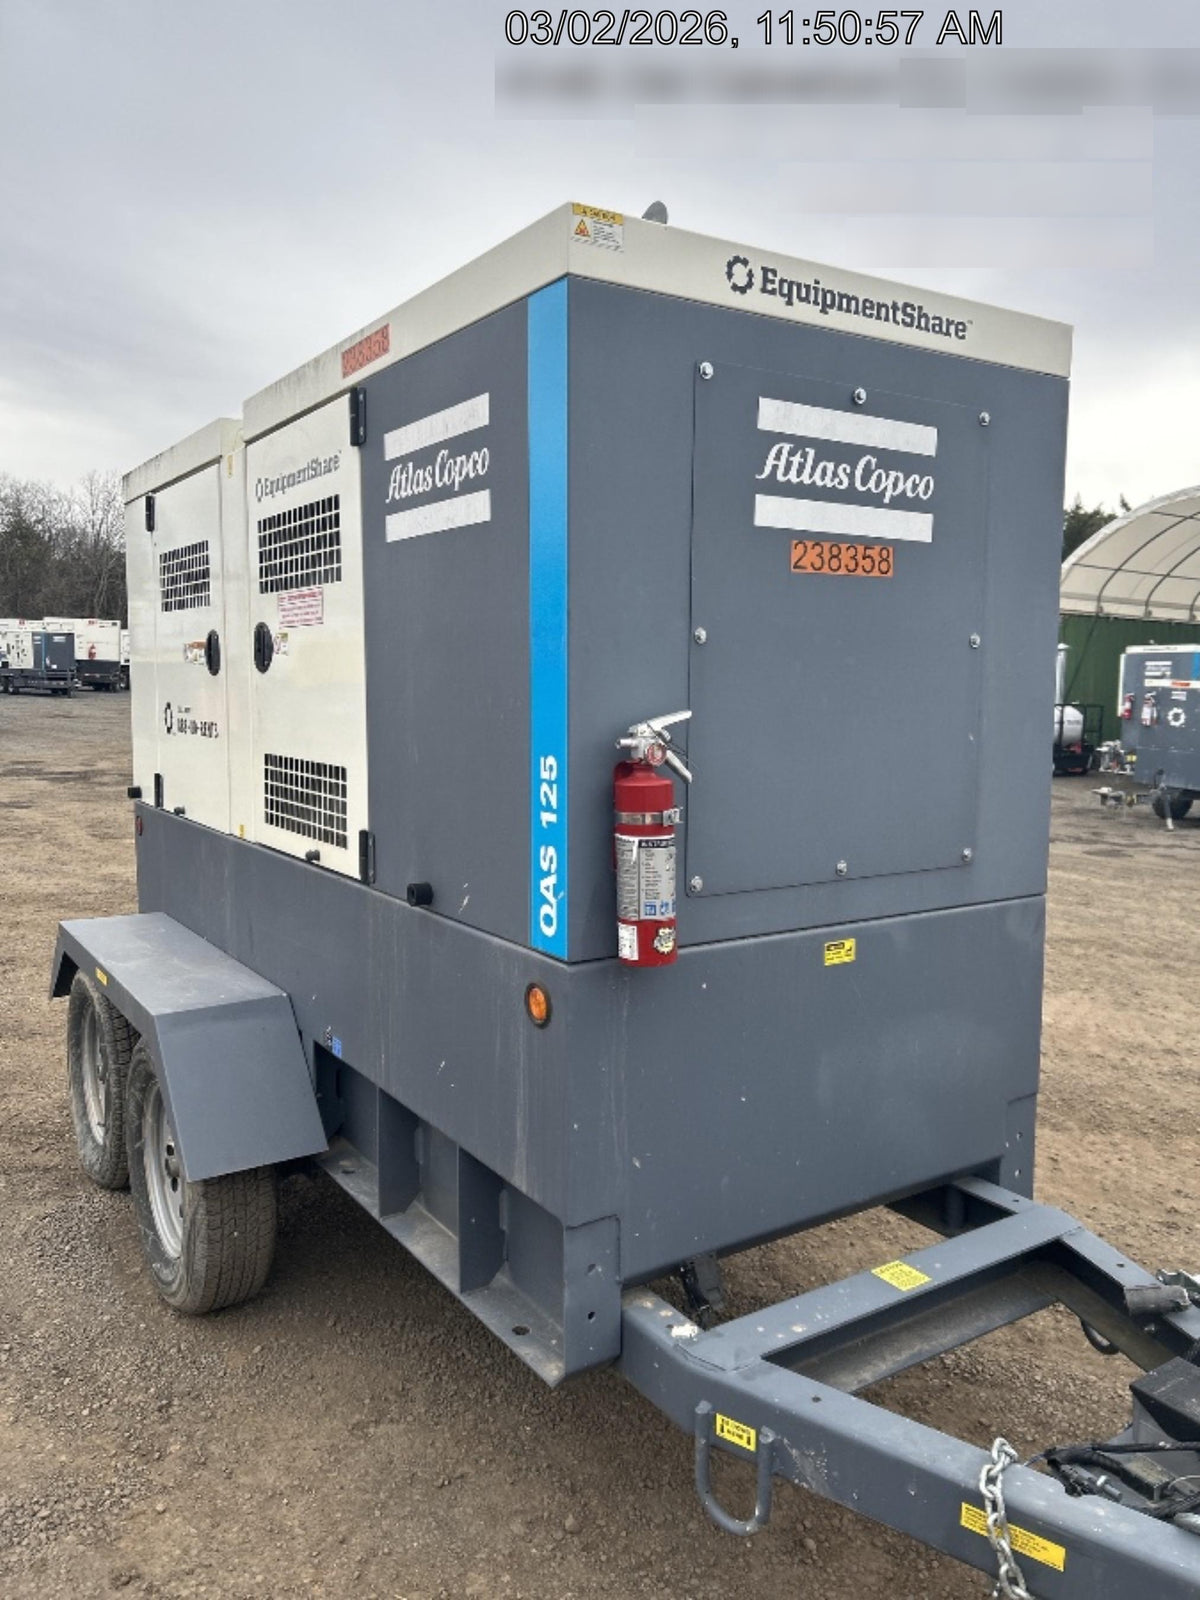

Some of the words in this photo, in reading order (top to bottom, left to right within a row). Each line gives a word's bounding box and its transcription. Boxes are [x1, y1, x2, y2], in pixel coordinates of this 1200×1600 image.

[760, 265, 968, 340] EquipmentShare
[386, 461, 433, 503] Atlas
[435, 447, 490, 491] Copco
[756, 442, 850, 490] Atlas
[854, 455, 935, 503] Copco
[793, 541, 892, 575] 238358
[539, 755, 558, 829] 125
[539, 845, 558, 937] QAS
